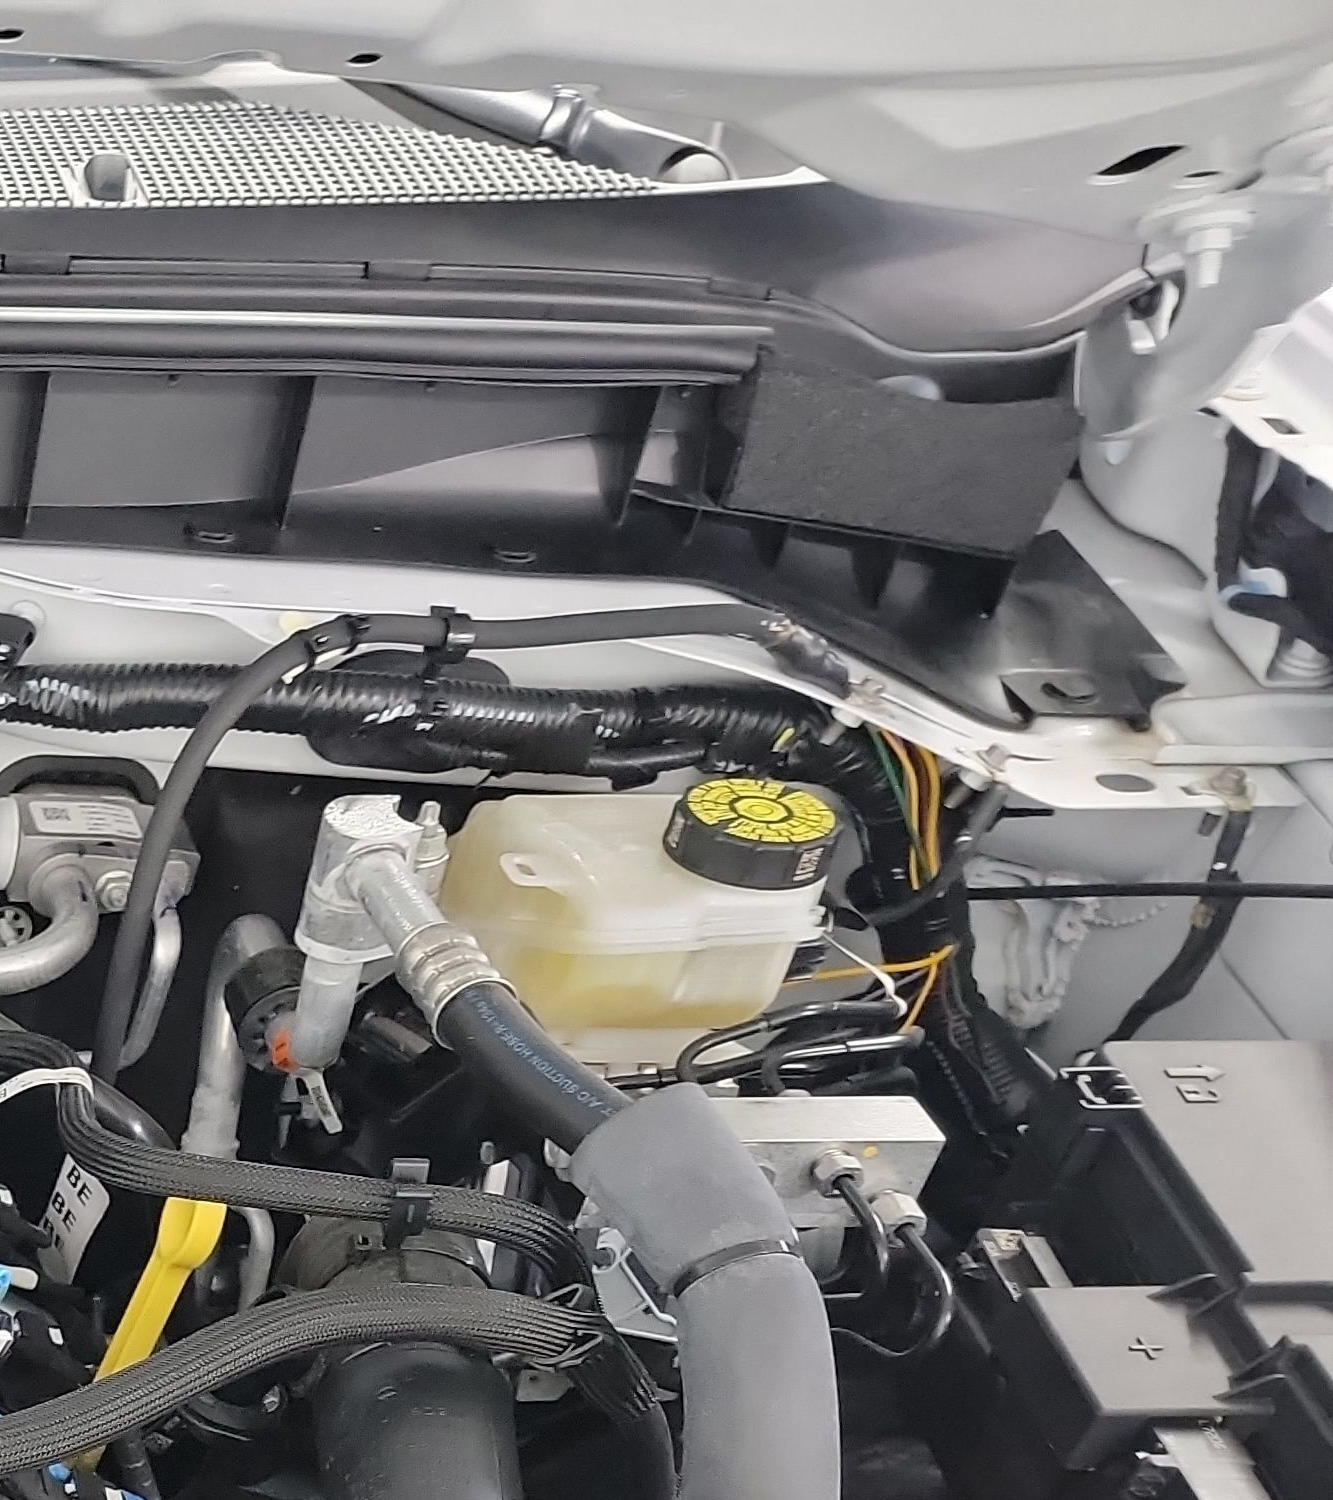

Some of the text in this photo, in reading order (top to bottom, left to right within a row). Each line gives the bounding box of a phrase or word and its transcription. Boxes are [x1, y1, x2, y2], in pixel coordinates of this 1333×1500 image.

[527, 1054, 579, 1094] SUCTION
[577, 1091, 603, 1108] A/C
[68, 1165, 92, 1206] BE
[52, 1191, 76, 1232] BE
